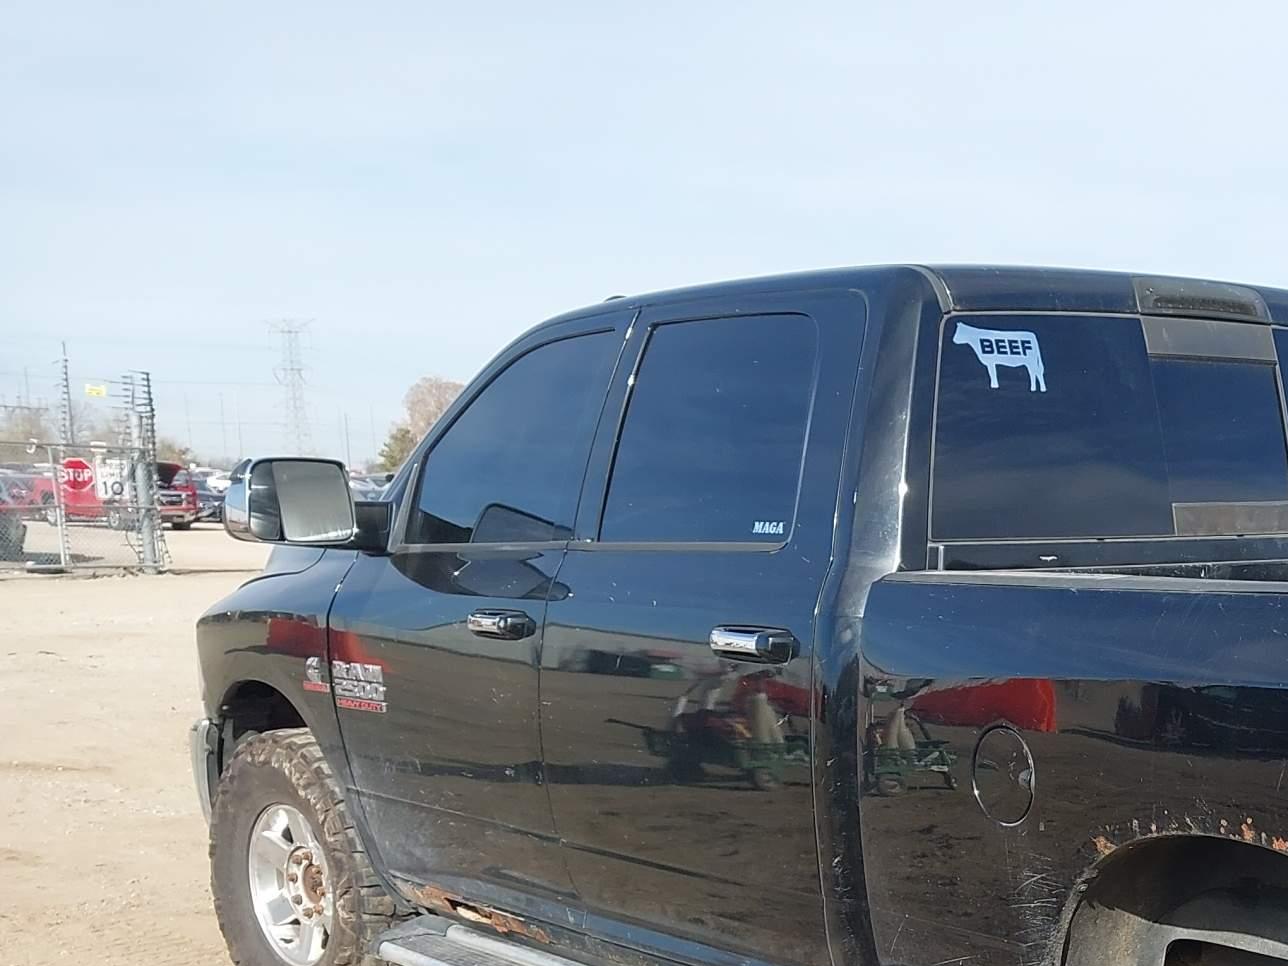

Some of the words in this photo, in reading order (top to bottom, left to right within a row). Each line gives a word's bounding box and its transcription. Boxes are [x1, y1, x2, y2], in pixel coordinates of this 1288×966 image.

[979, 338, 1032, 357] BEEF
[58, 468, 91, 482] STOP
[103, 481, 124, 496] 10
[752, 521, 784, 534] MAGA
